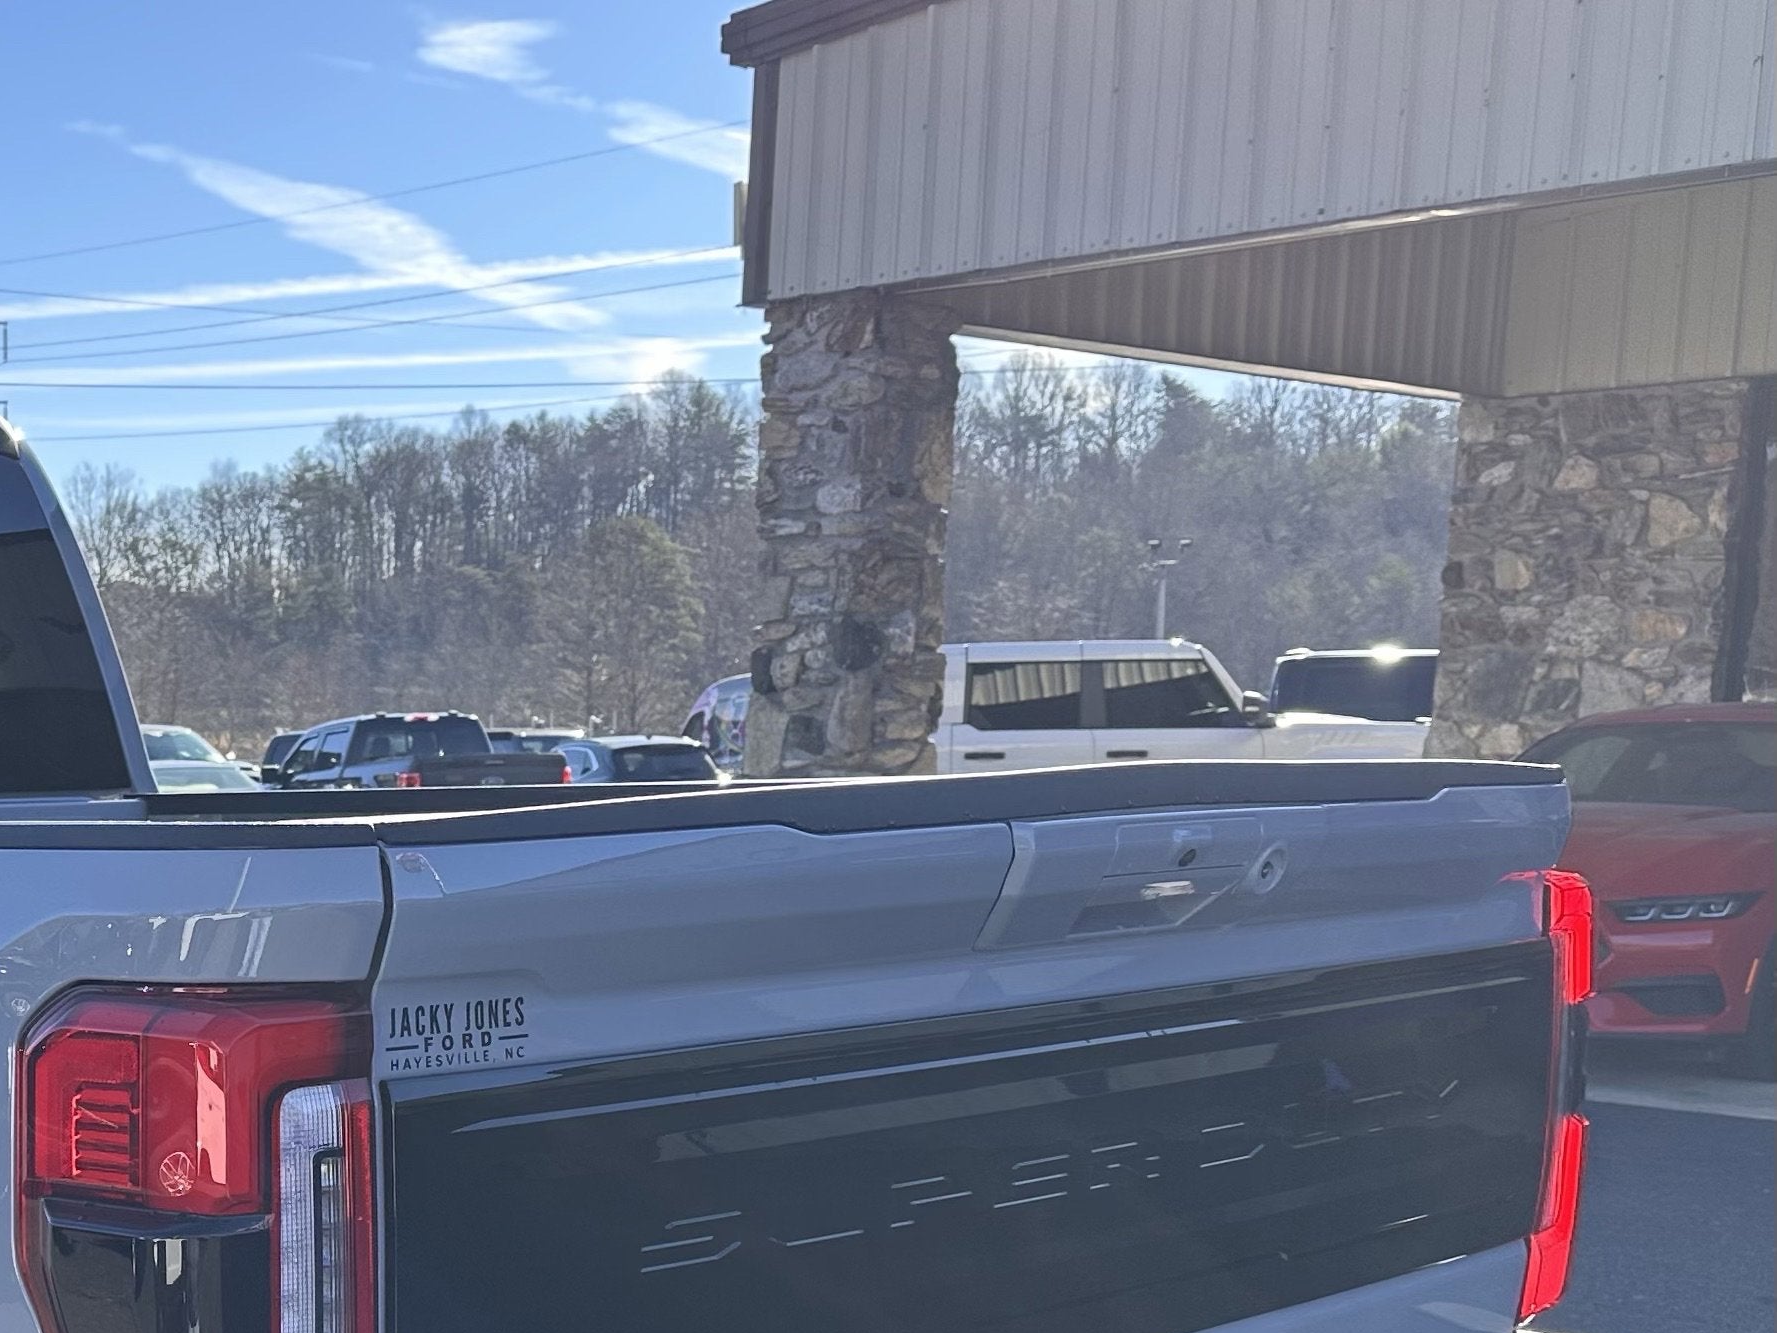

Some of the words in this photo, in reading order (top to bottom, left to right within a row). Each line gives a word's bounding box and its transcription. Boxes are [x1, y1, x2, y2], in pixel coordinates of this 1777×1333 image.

[389, 1002, 455, 1039] JACKY
[464, 996, 525, 1031] JONES
[424, 1031, 492, 1053] FORD
[390, 1050, 497, 1072] HAYESVILLE,
[505, 1046, 525, 1060] NC
